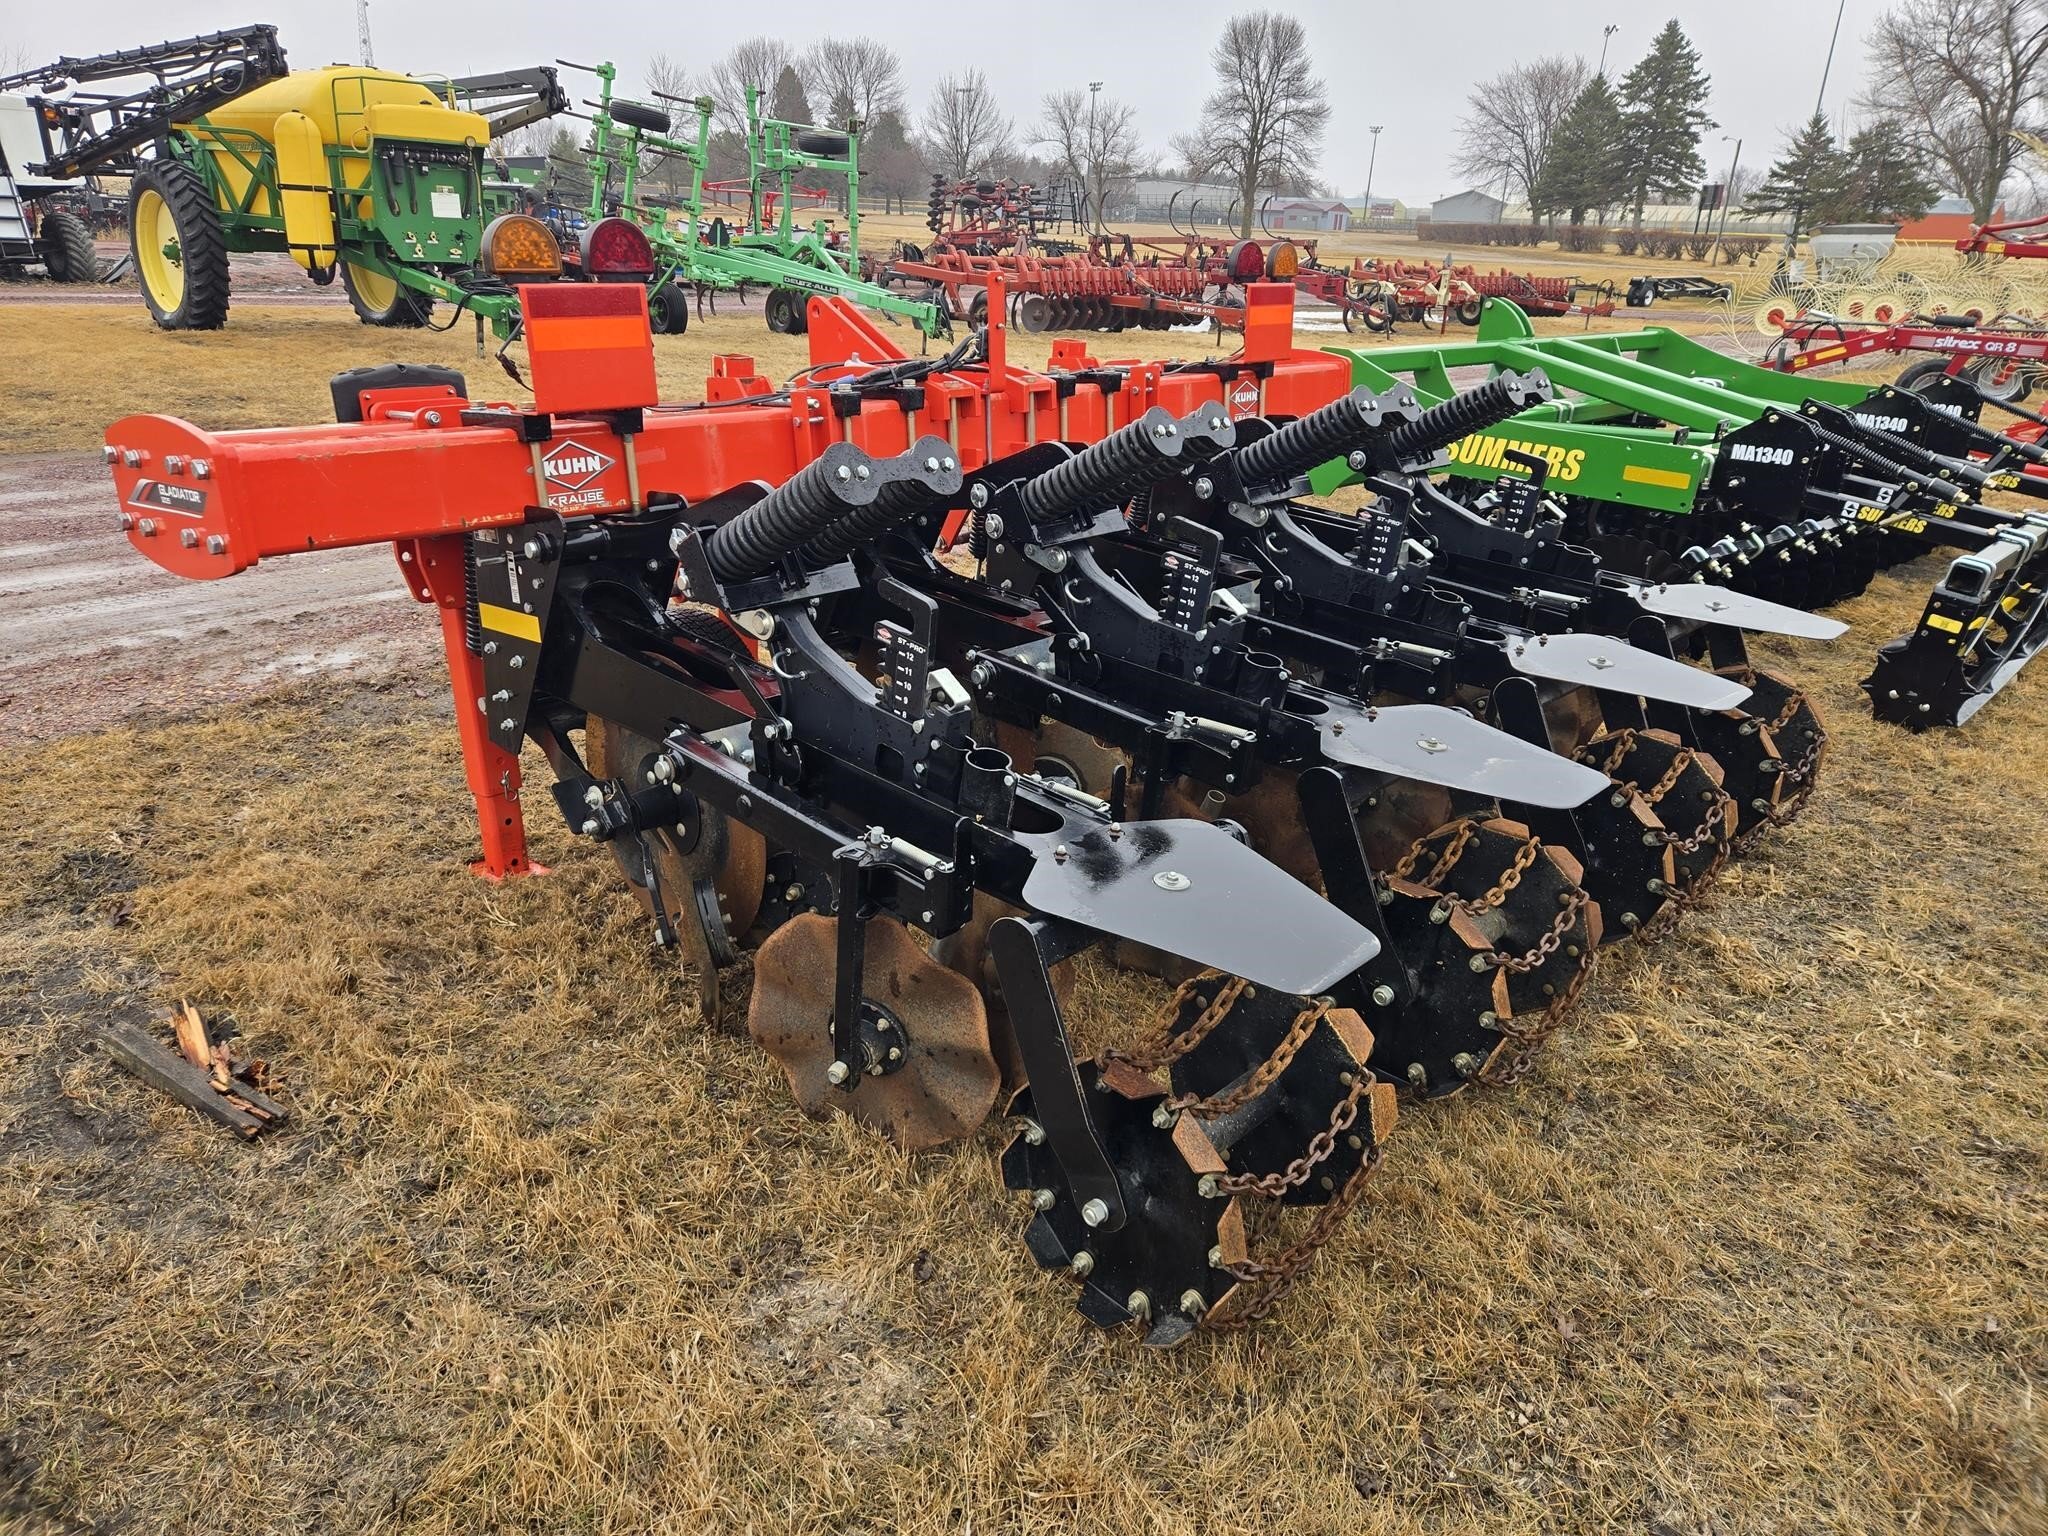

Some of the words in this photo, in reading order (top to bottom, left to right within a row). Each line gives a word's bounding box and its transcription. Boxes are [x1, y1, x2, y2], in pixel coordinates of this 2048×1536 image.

[784, 276, 838, 294] DEUTZ-ALLIS
[1934, 336, 1982, 350] sitrex
[2005, 342, 2017, 353] 8
[1235, 390, 1258, 402] KUHN
[1730, 444, 1794, 466] MA1340
[543, 455, 601, 477] KUHN
[158, 484, 202, 503] GLADIATOR
[548, 491, 604, 507] KRAUSE
